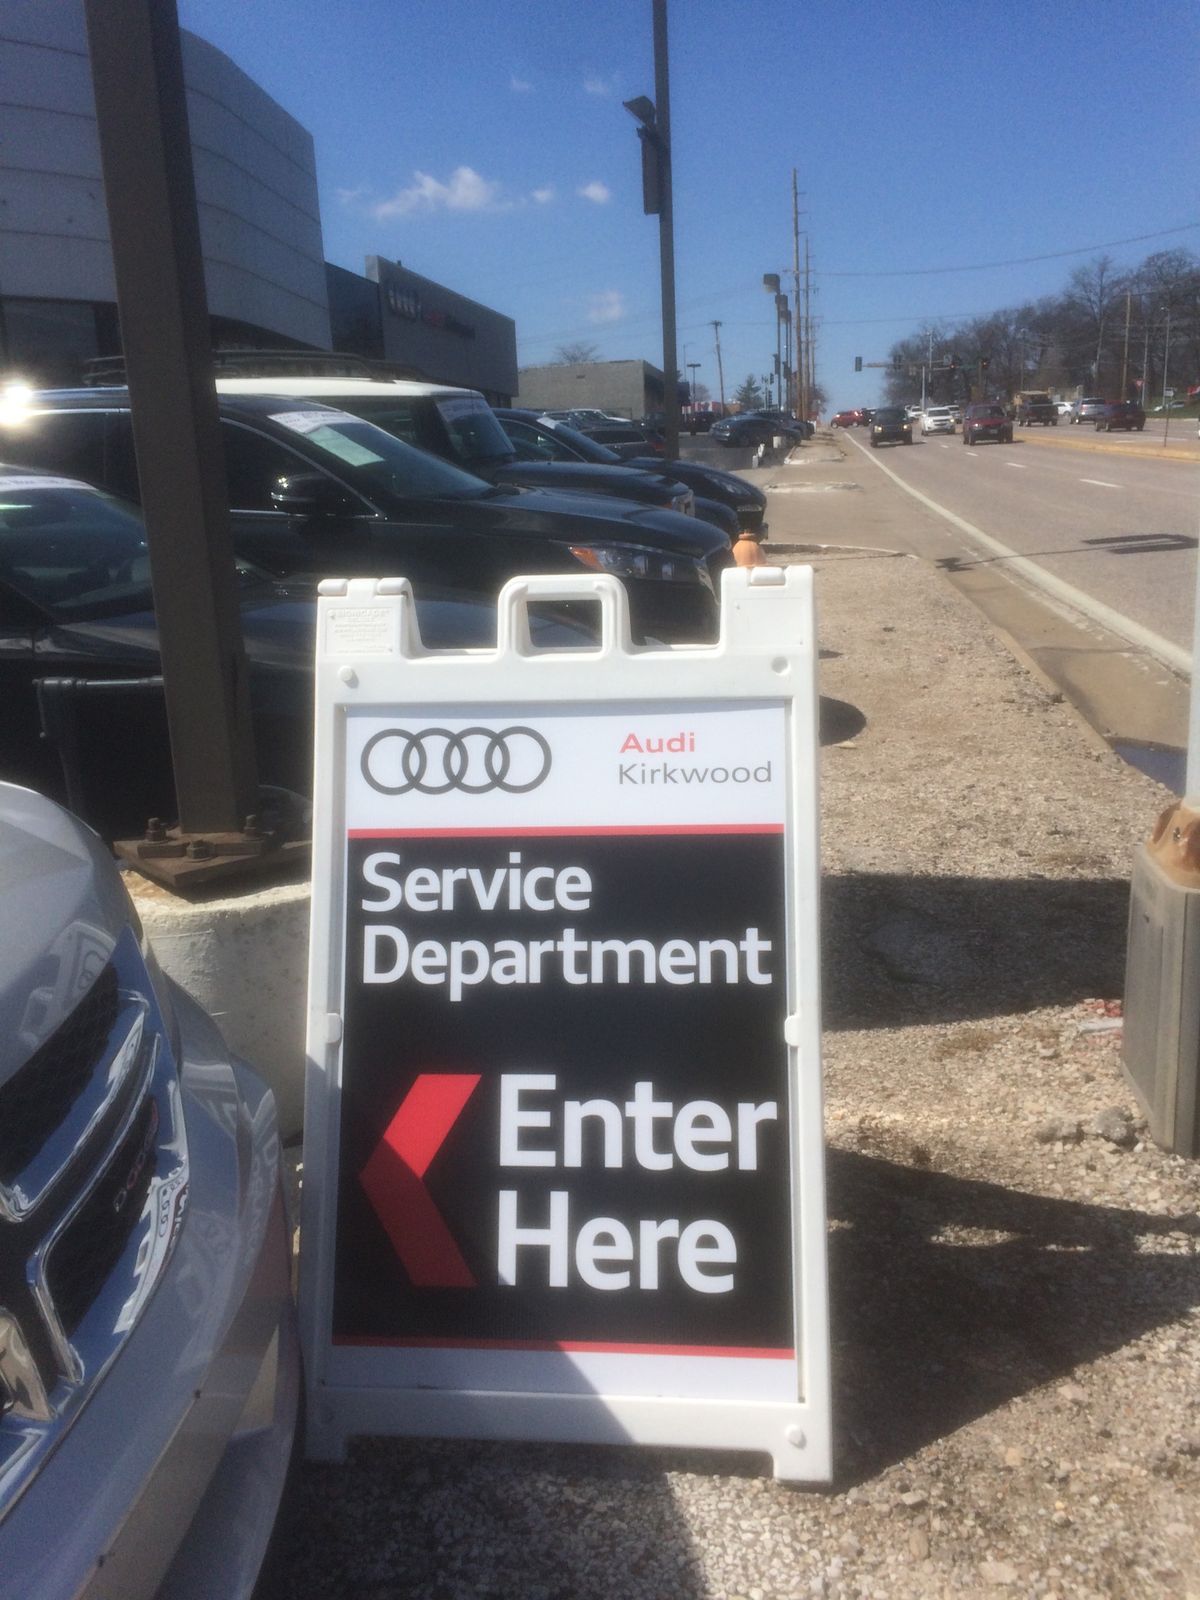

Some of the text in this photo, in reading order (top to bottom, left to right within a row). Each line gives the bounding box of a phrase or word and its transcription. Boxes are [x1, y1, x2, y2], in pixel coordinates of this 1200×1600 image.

[619, 760, 772, 785] Kirkwood
[620, 732, 695, 753] Audi
[361, 851, 593, 913] Service
[362, 924, 773, 1002] Department
[499, 1073, 778, 1172] Enter
[497, 1189, 738, 1294] Here
